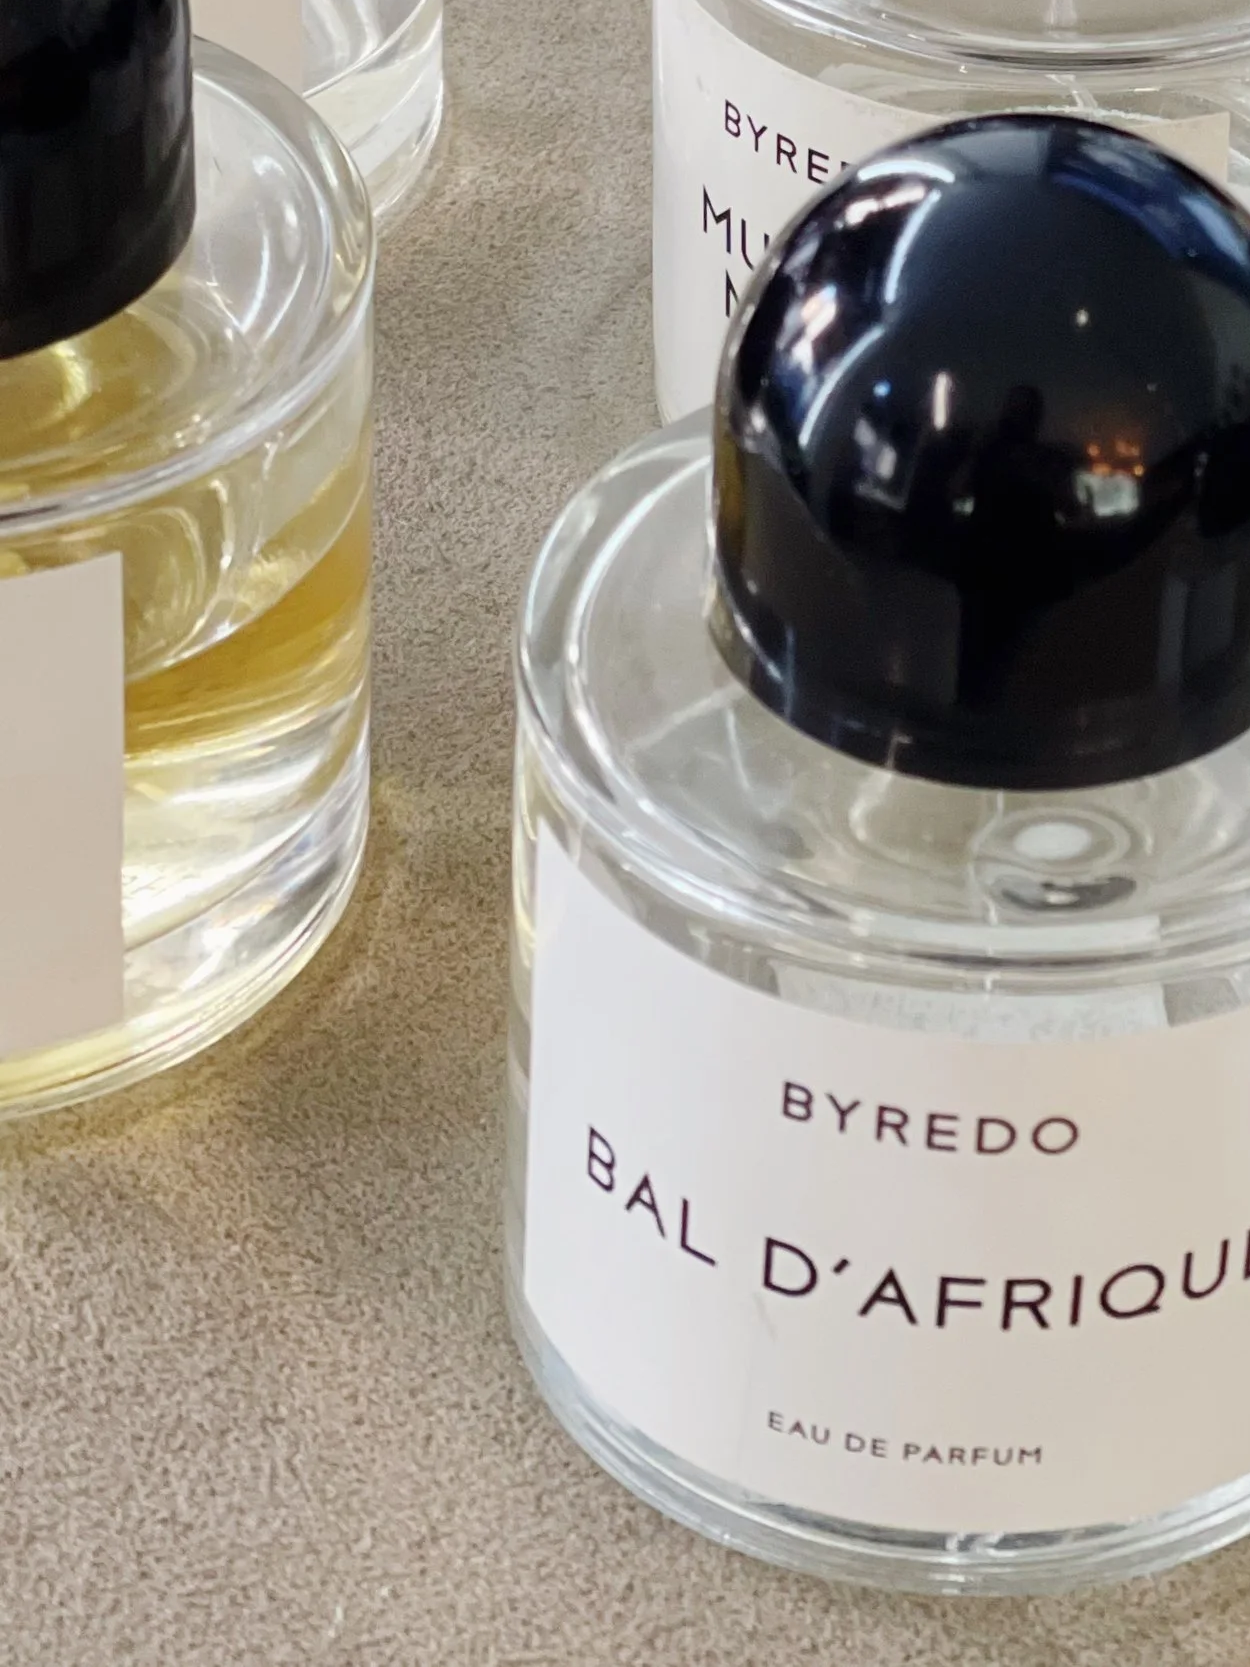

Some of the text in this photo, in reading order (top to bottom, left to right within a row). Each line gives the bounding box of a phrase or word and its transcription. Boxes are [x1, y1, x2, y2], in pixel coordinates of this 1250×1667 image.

[724, 99, 852, 185] BYRE
[782, 1081, 1080, 1155] BYREDO
[587, 1126, 719, 1267] BAL
[767, 1409, 1043, 1467] EAU DE PARFUM
